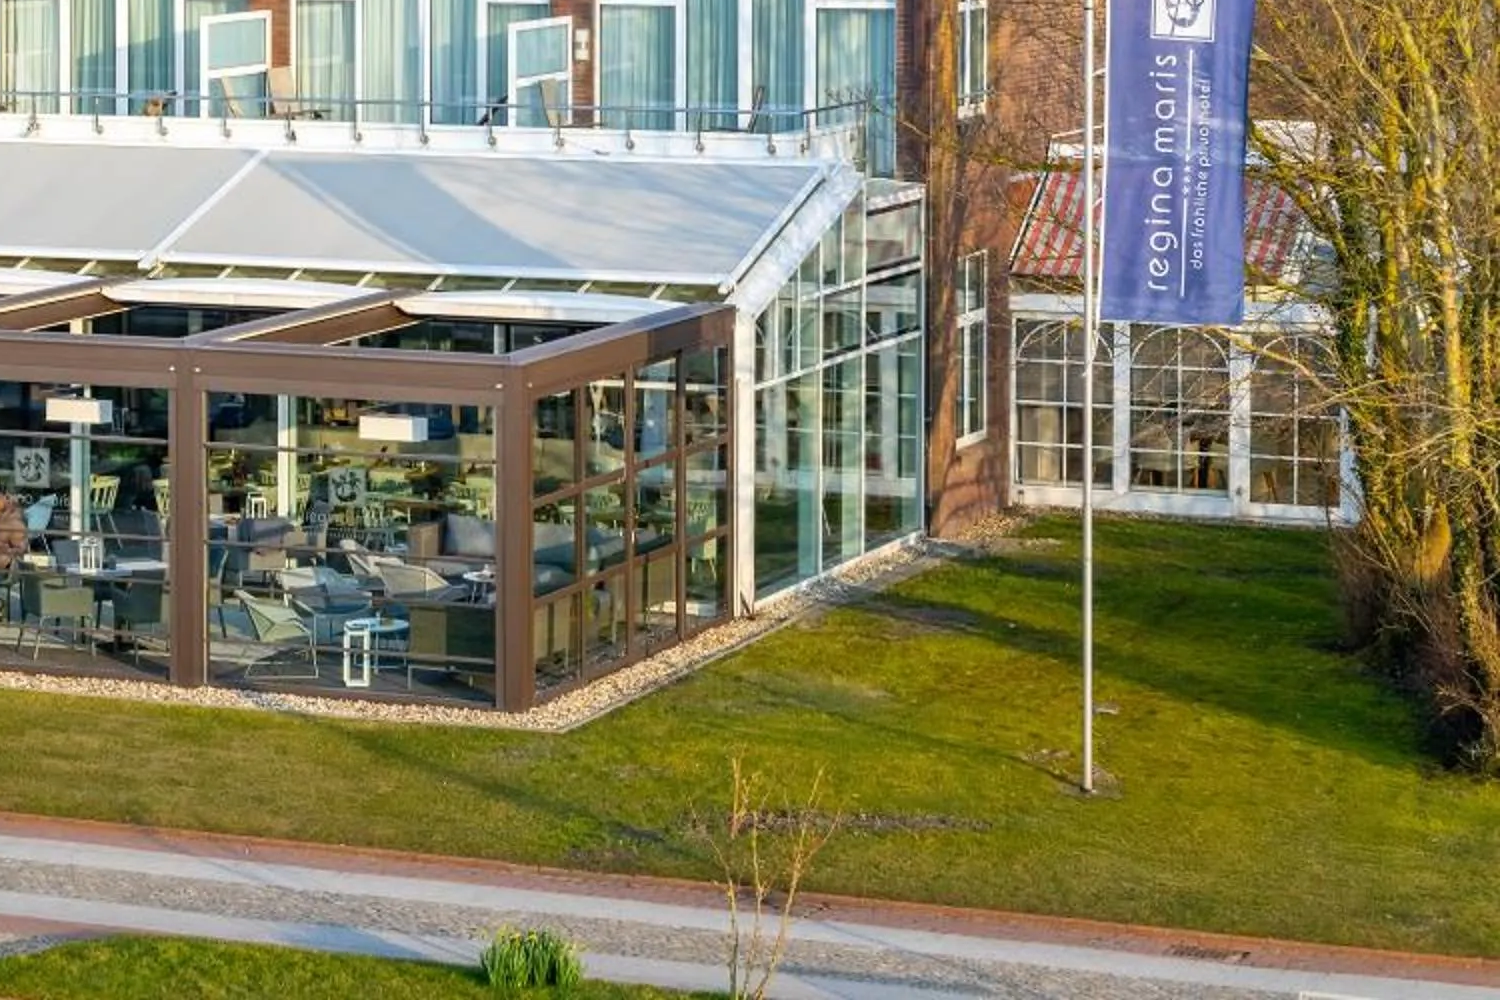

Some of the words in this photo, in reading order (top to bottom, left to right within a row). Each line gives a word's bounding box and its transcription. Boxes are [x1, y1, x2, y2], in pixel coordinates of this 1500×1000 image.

[1149, 54, 1177, 153] maris
[1144, 167, 1178, 291] regina
[1189, 241, 1204, 270] das
